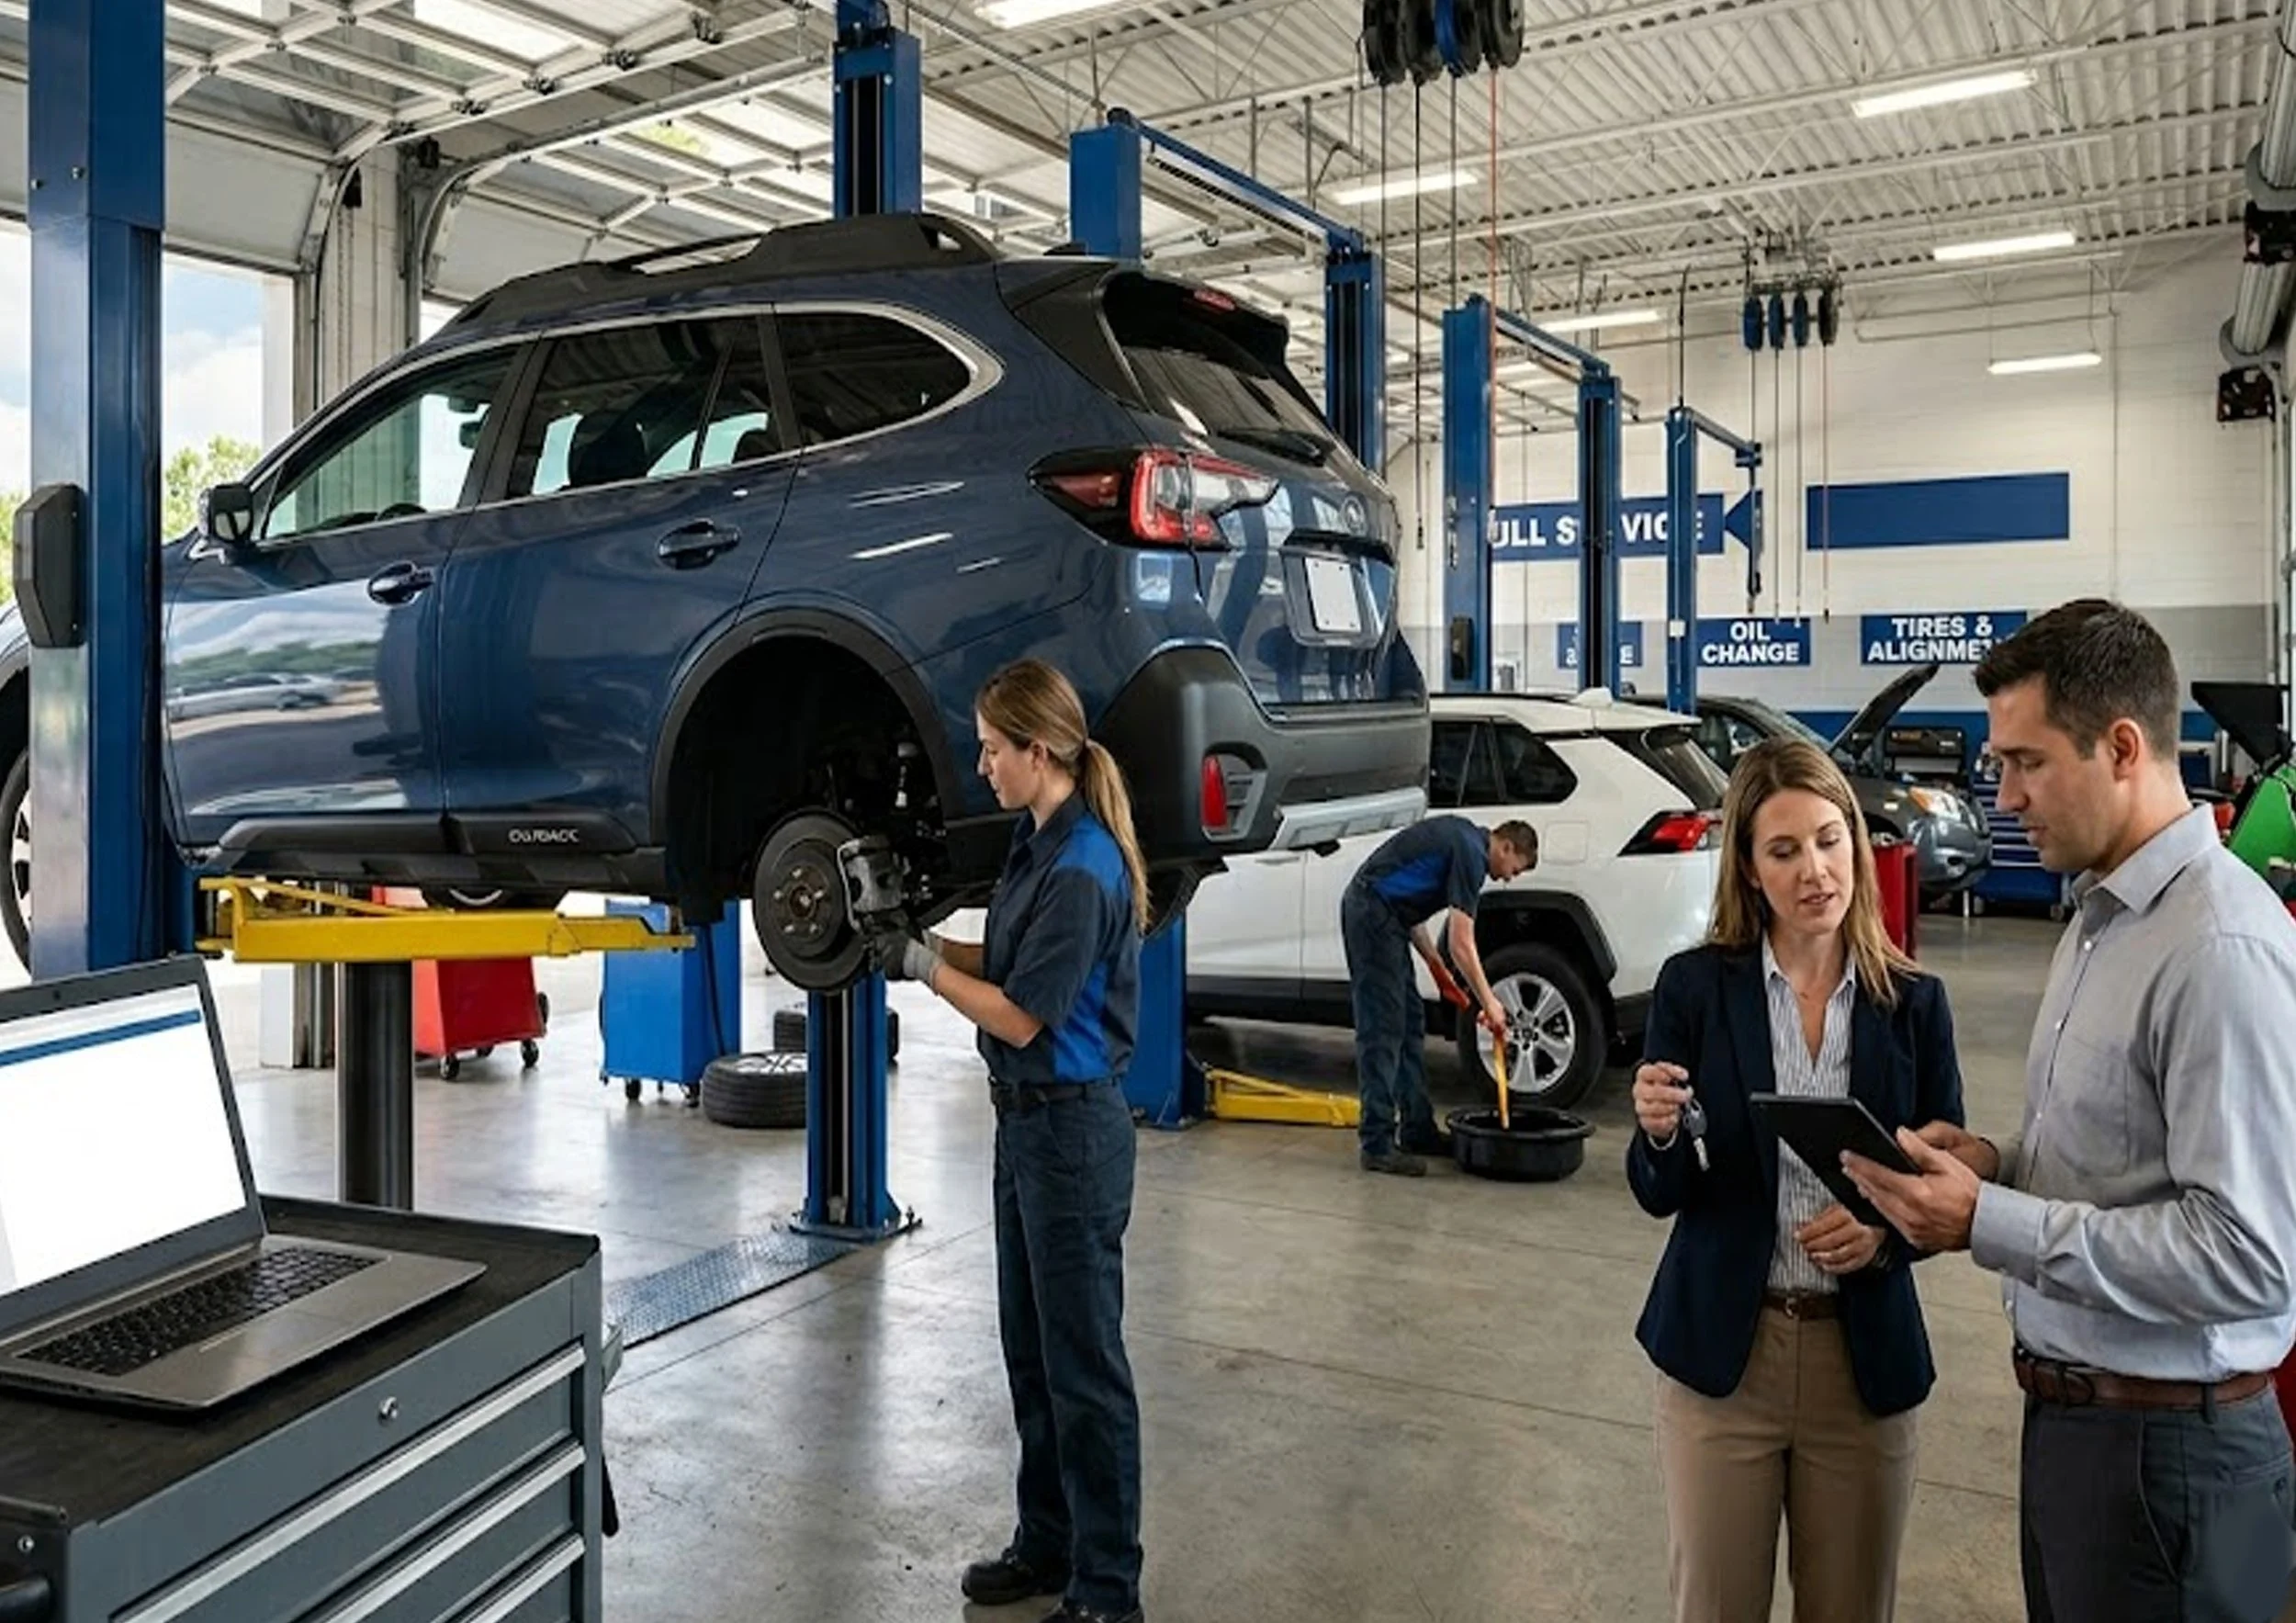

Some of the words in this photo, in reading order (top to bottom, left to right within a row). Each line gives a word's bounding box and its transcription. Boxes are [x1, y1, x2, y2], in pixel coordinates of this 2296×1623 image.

[1556, 511, 1705, 546] SVIC
[1730, 621, 1771, 641] OIL
[1891, 616, 1967, 638] TIRES
[1975, 614, 1994, 637] &
[1702, 642, 1800, 664] CHANGE
[1867, 637, 2003, 661] ALIGNME
